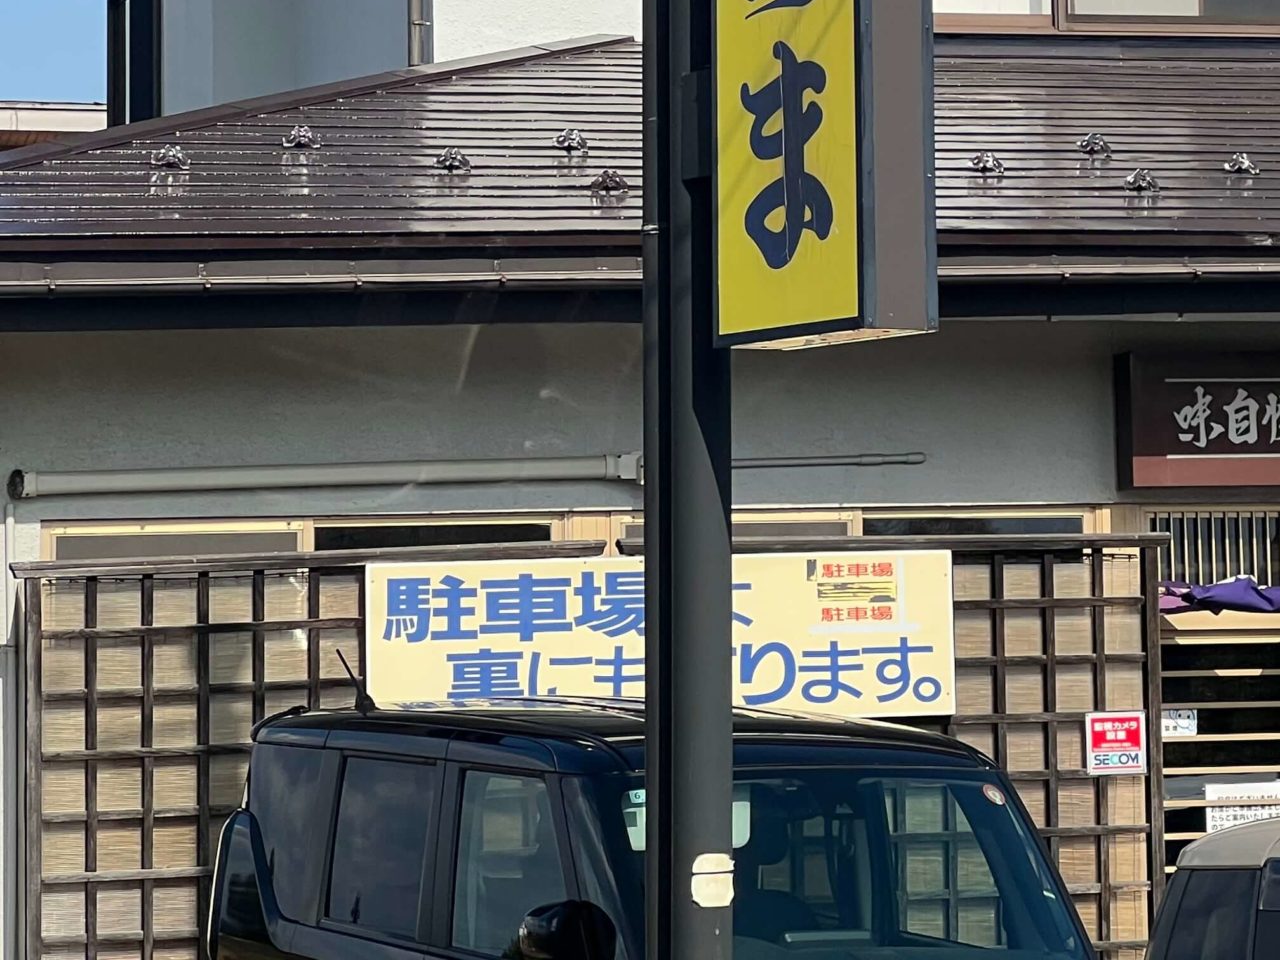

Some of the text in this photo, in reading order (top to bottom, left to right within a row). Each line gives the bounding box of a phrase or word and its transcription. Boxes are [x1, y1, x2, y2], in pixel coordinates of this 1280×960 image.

[821, 563, 893, 578] 駐車場
[383, 571, 752, 642] 駐車場
[821, 606, 893, 622] 駐車場
[1094, 753, 1139, 766] SECOM
